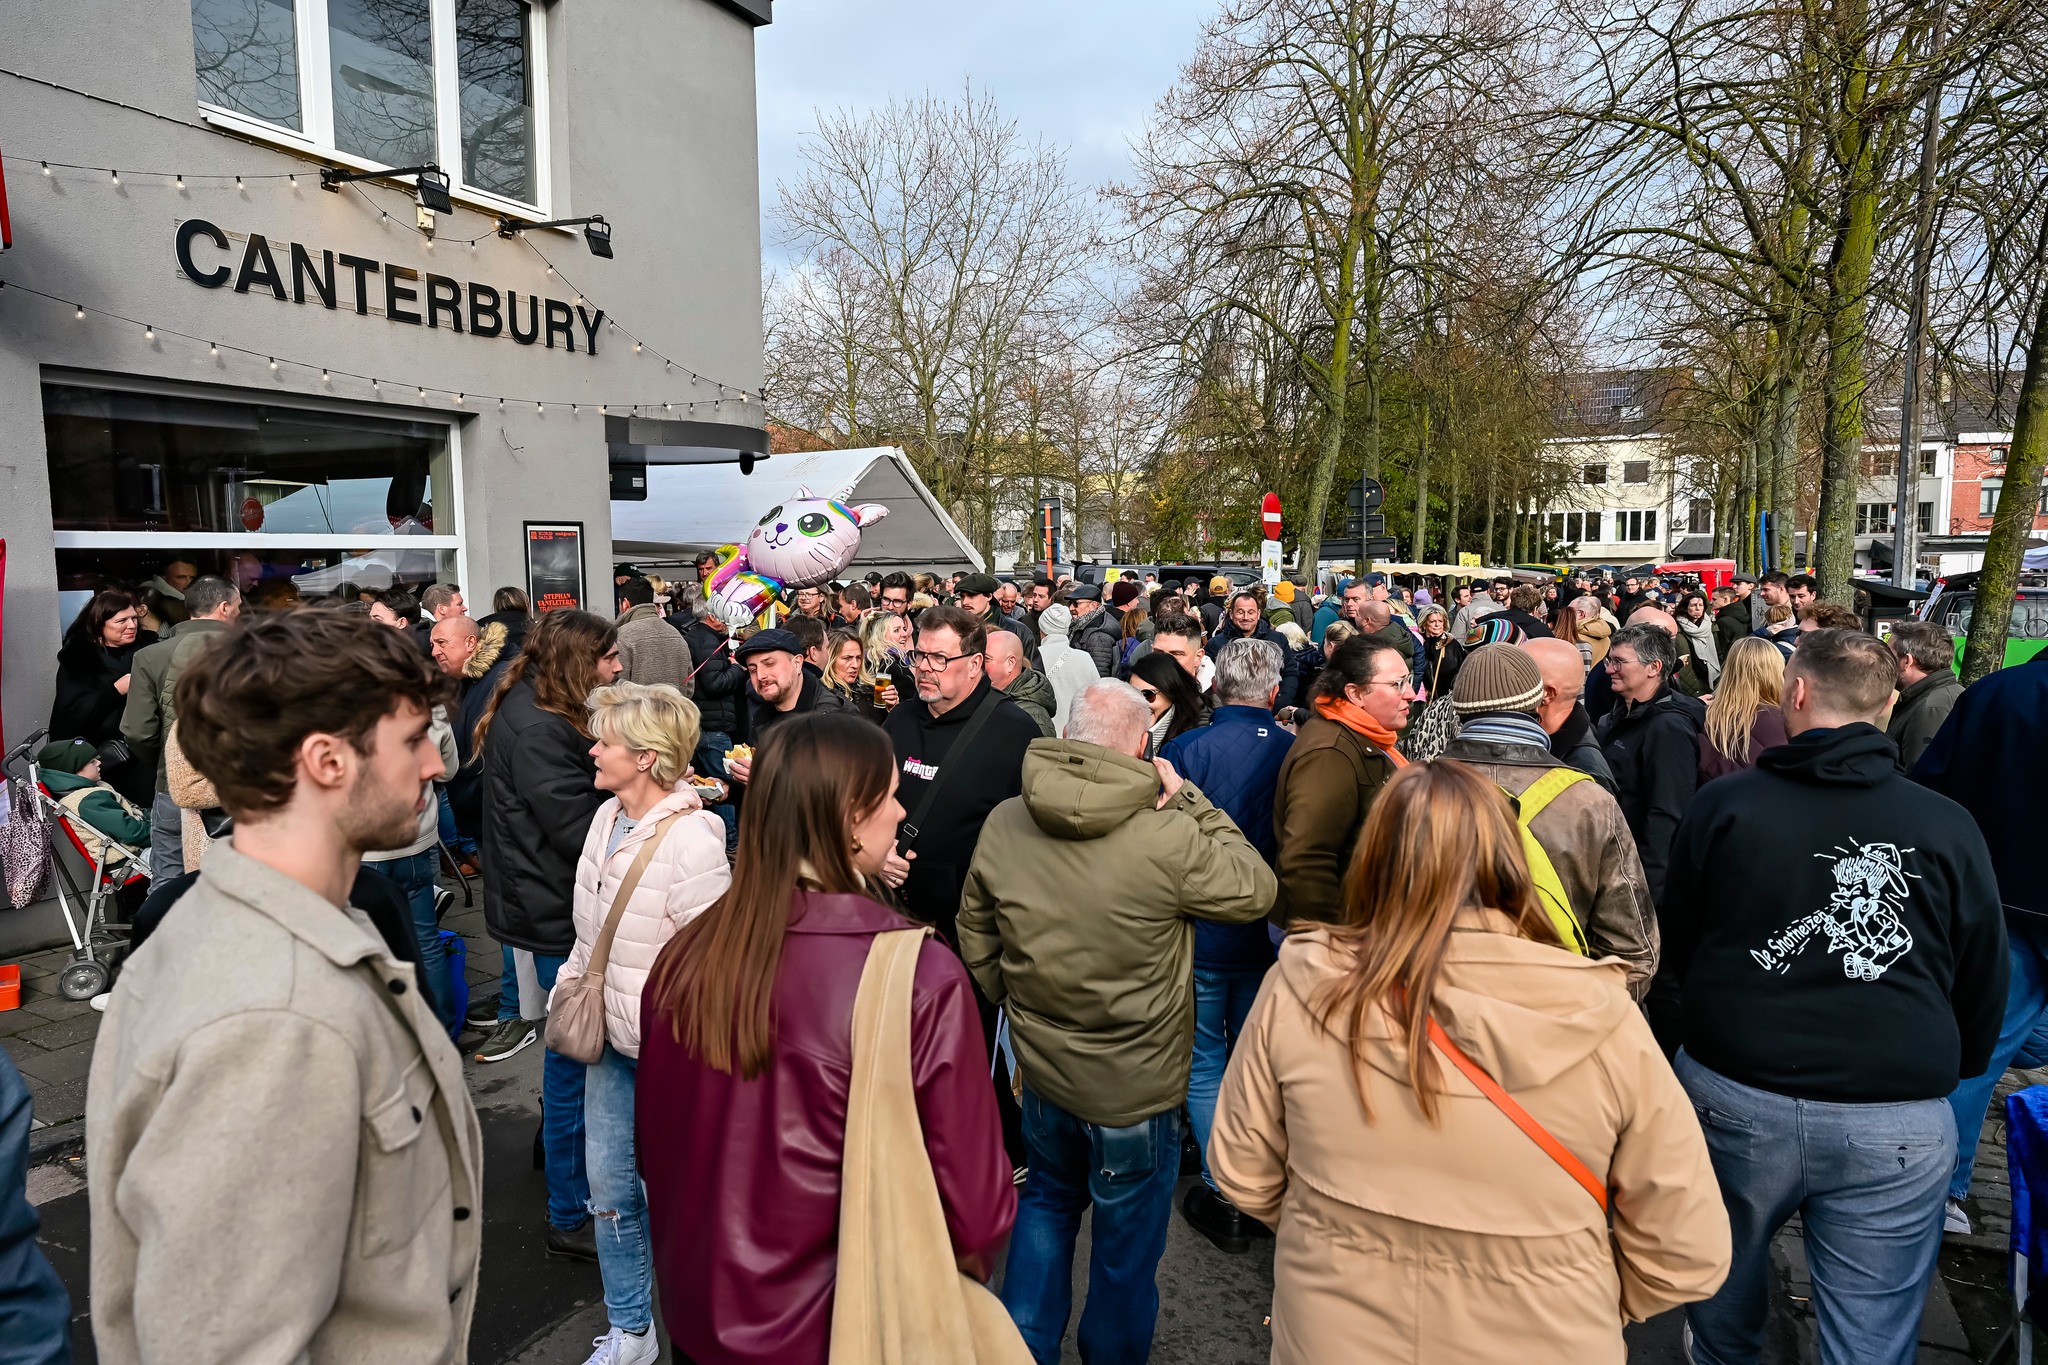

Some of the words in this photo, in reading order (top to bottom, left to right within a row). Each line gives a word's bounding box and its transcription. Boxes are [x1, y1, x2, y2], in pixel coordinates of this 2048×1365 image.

[173, 217, 605, 356] CANTERBURY
[1749, 949, 1777, 971] De
[1767, 910, 1829, 958] Snotneizen
